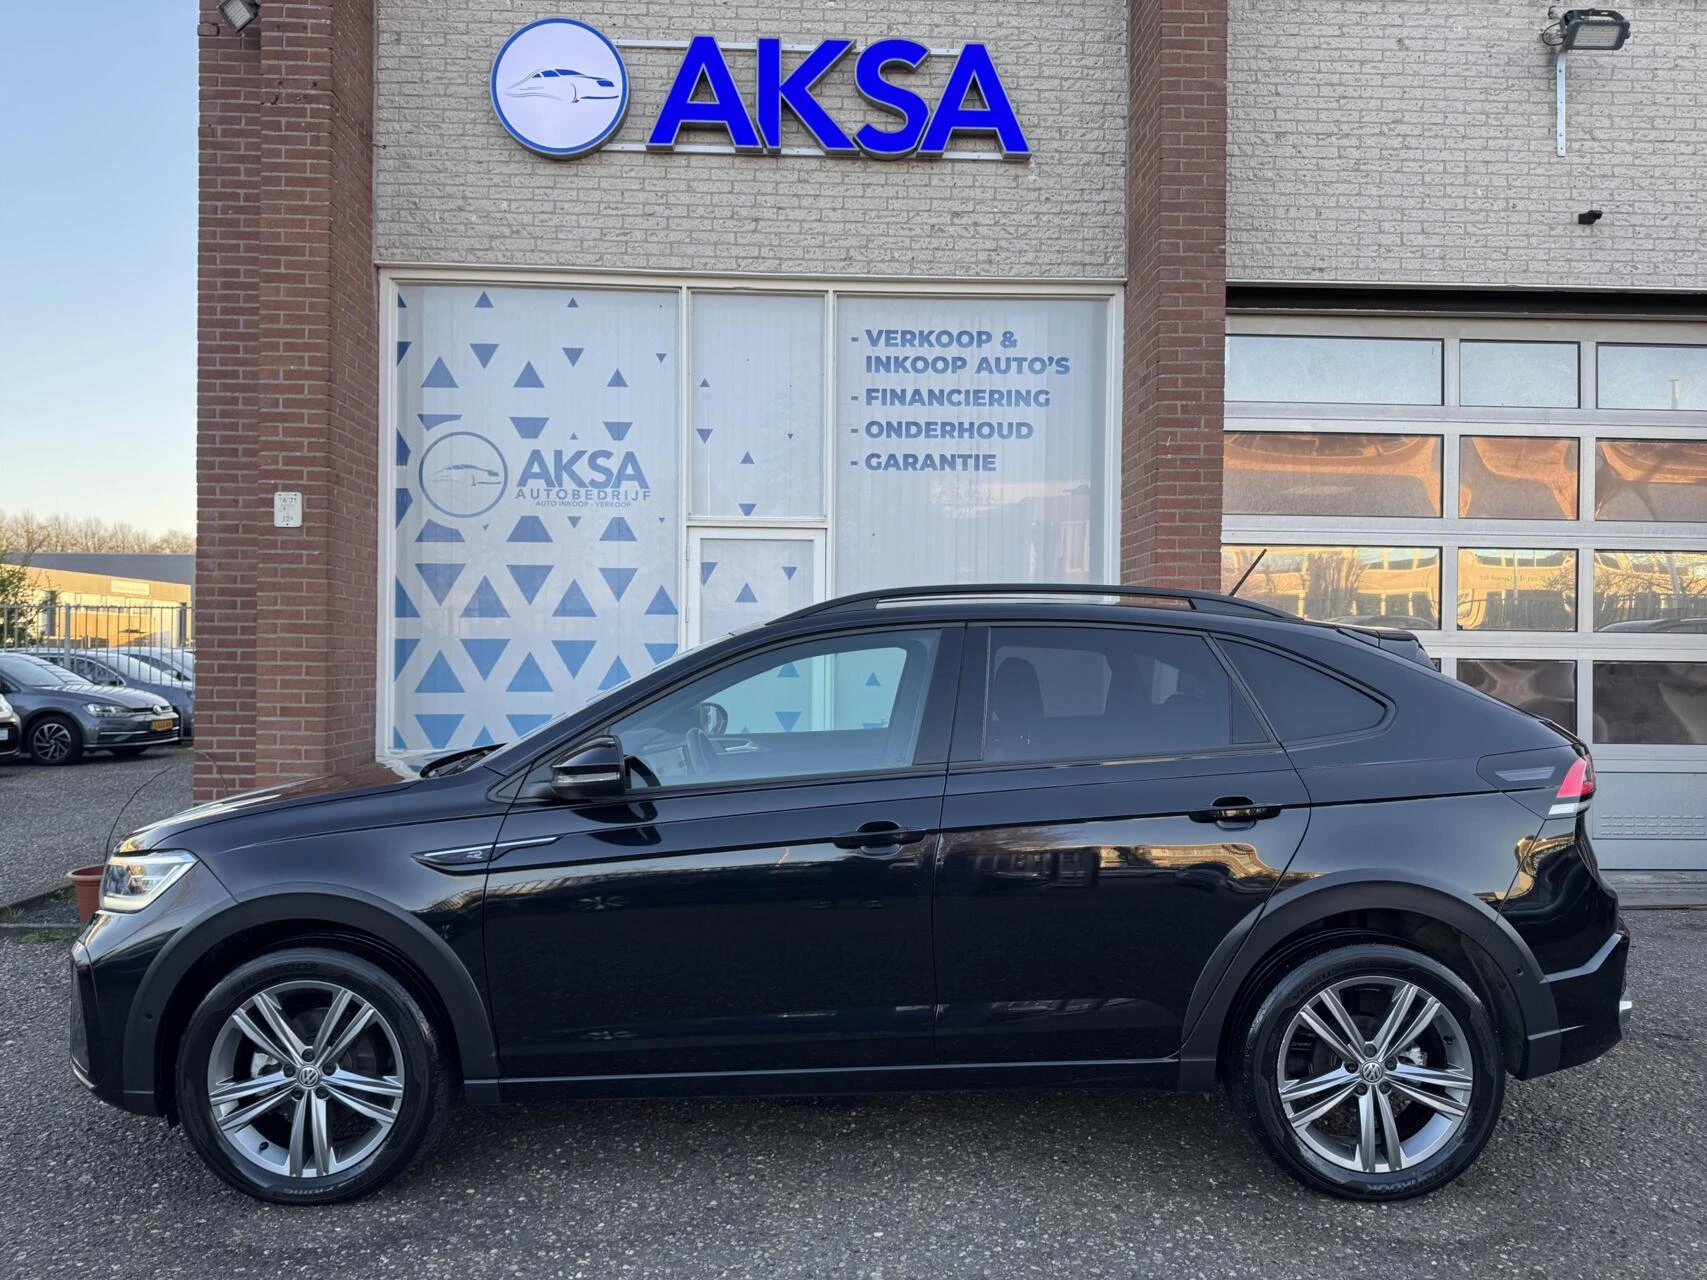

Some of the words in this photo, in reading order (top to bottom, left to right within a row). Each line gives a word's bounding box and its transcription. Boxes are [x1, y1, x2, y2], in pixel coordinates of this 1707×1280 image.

[646, 36, 1032, 160] AKSA
[865, 329, 993, 348] VERKOOP
[1000, 331, 1018, 349] &
[865, 355, 968, 374] INKOOP
[974, 356, 1071, 375] AUTO'S
[865, 388, 1051, 408] FINANCIERING
[865, 420, 1033, 440] ONDERHOUD
[516, 449, 650, 490] AKSA
[865, 452, 997, 472] GARANTIE
[515, 488, 651, 502] AUTOBEDRIJF
[558, 500, 589, 508] INKOOP
[595, 501, 631, 509] VERKOOP
